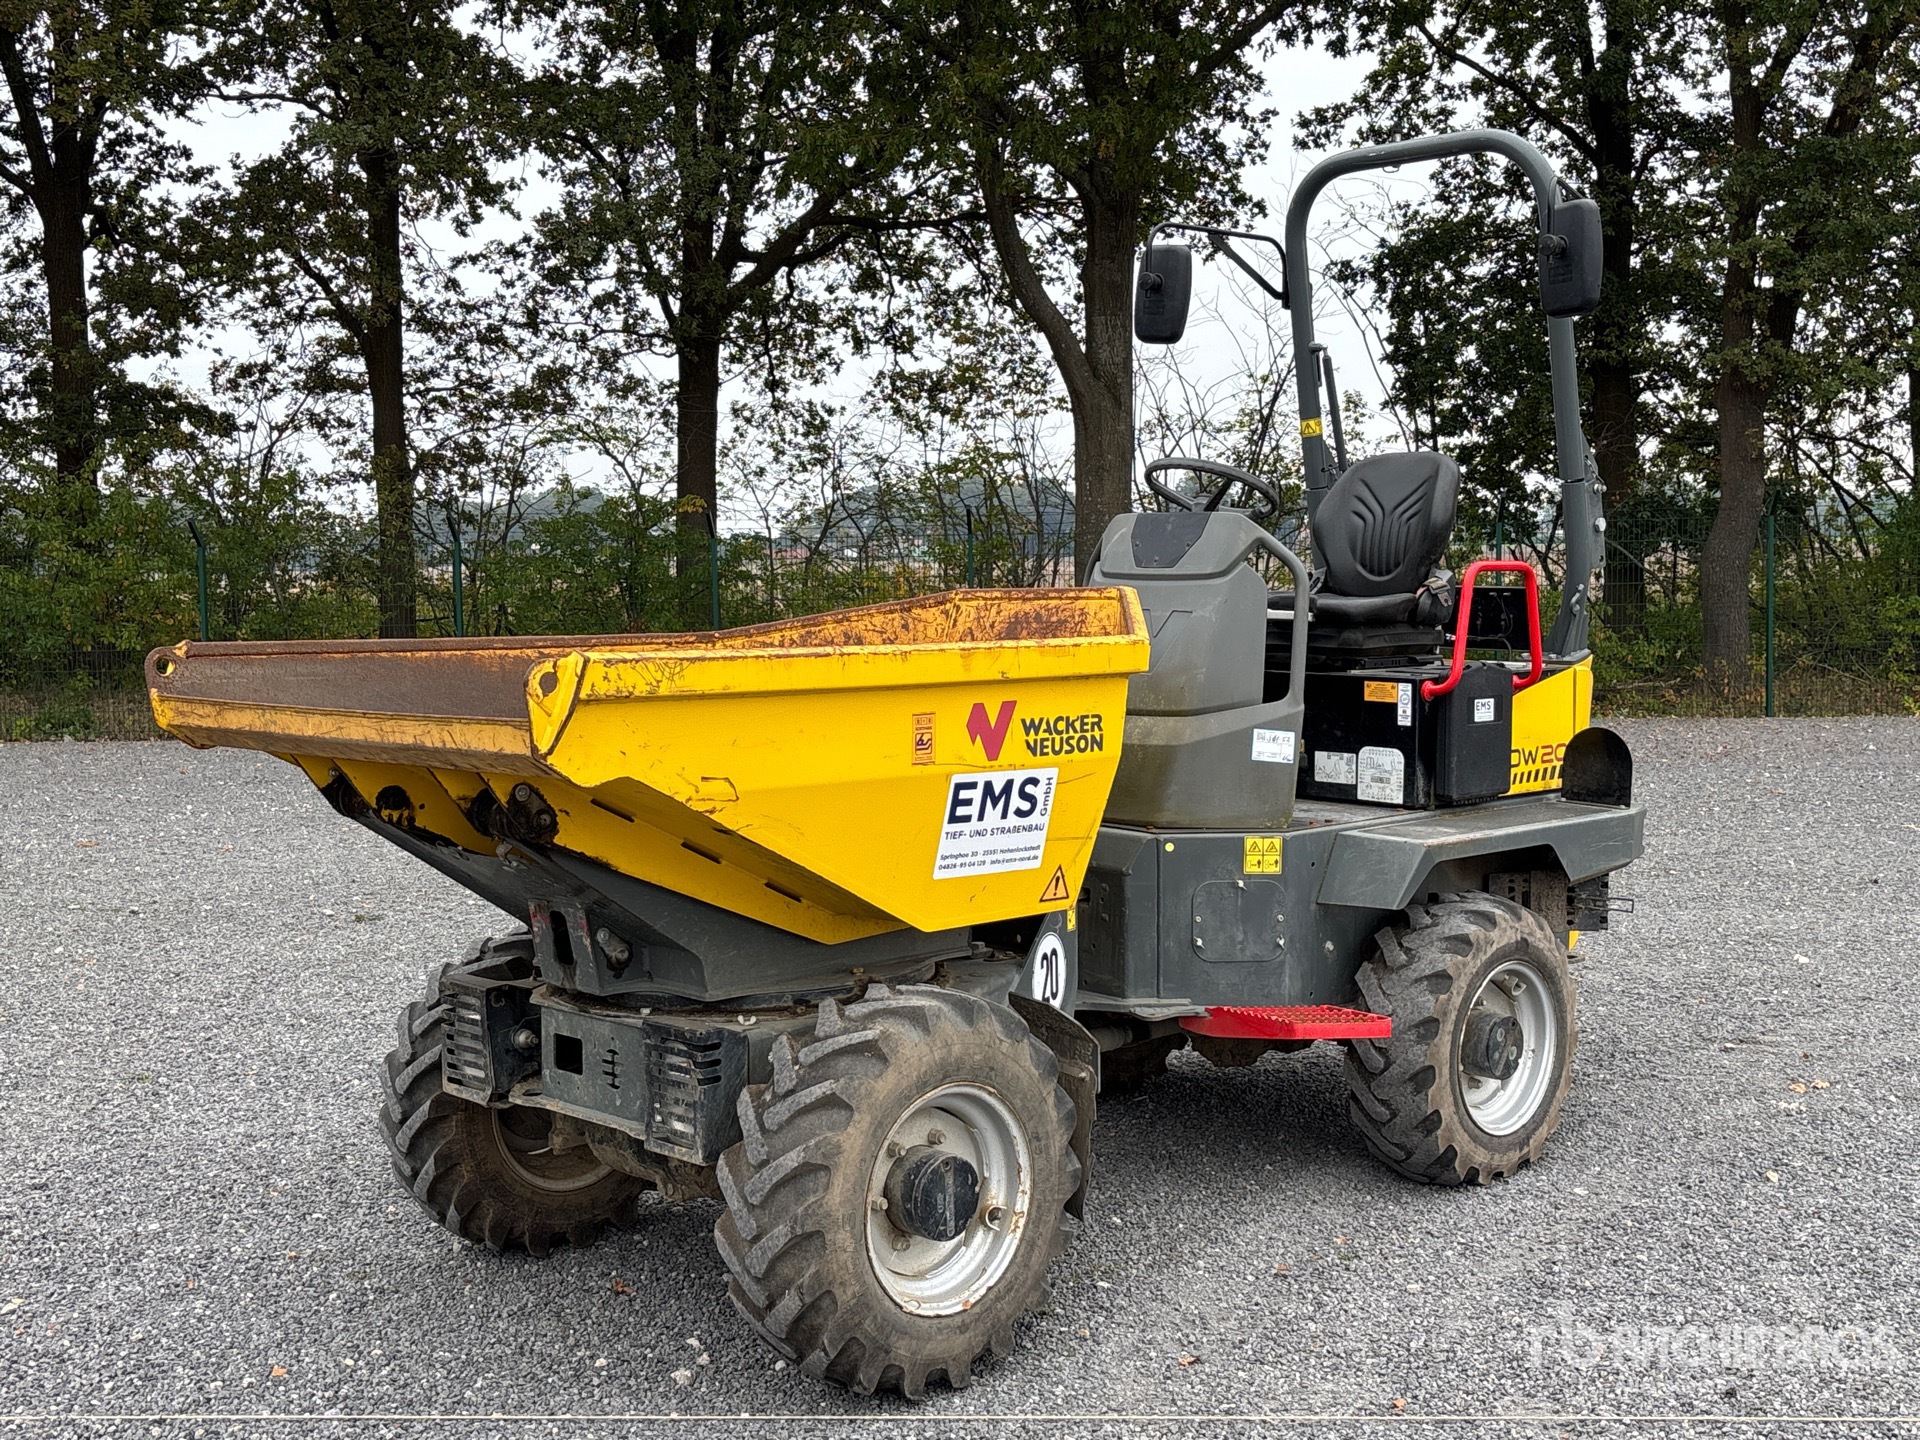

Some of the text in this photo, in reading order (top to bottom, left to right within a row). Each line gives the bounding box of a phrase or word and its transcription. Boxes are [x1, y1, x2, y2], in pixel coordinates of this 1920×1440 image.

[1476, 700, 1491, 711] EMS
[1020, 713, 1103, 737] WACKER
[1026, 731, 1104, 757] NEUSON
[947, 776, 1041, 824] EMS
[1040, 777, 1053, 817] GmbH
[945, 831, 967, 840] TIEF-
[969, 828, 988, 838] UND
[1041, 947, 1059, 1001] 20
